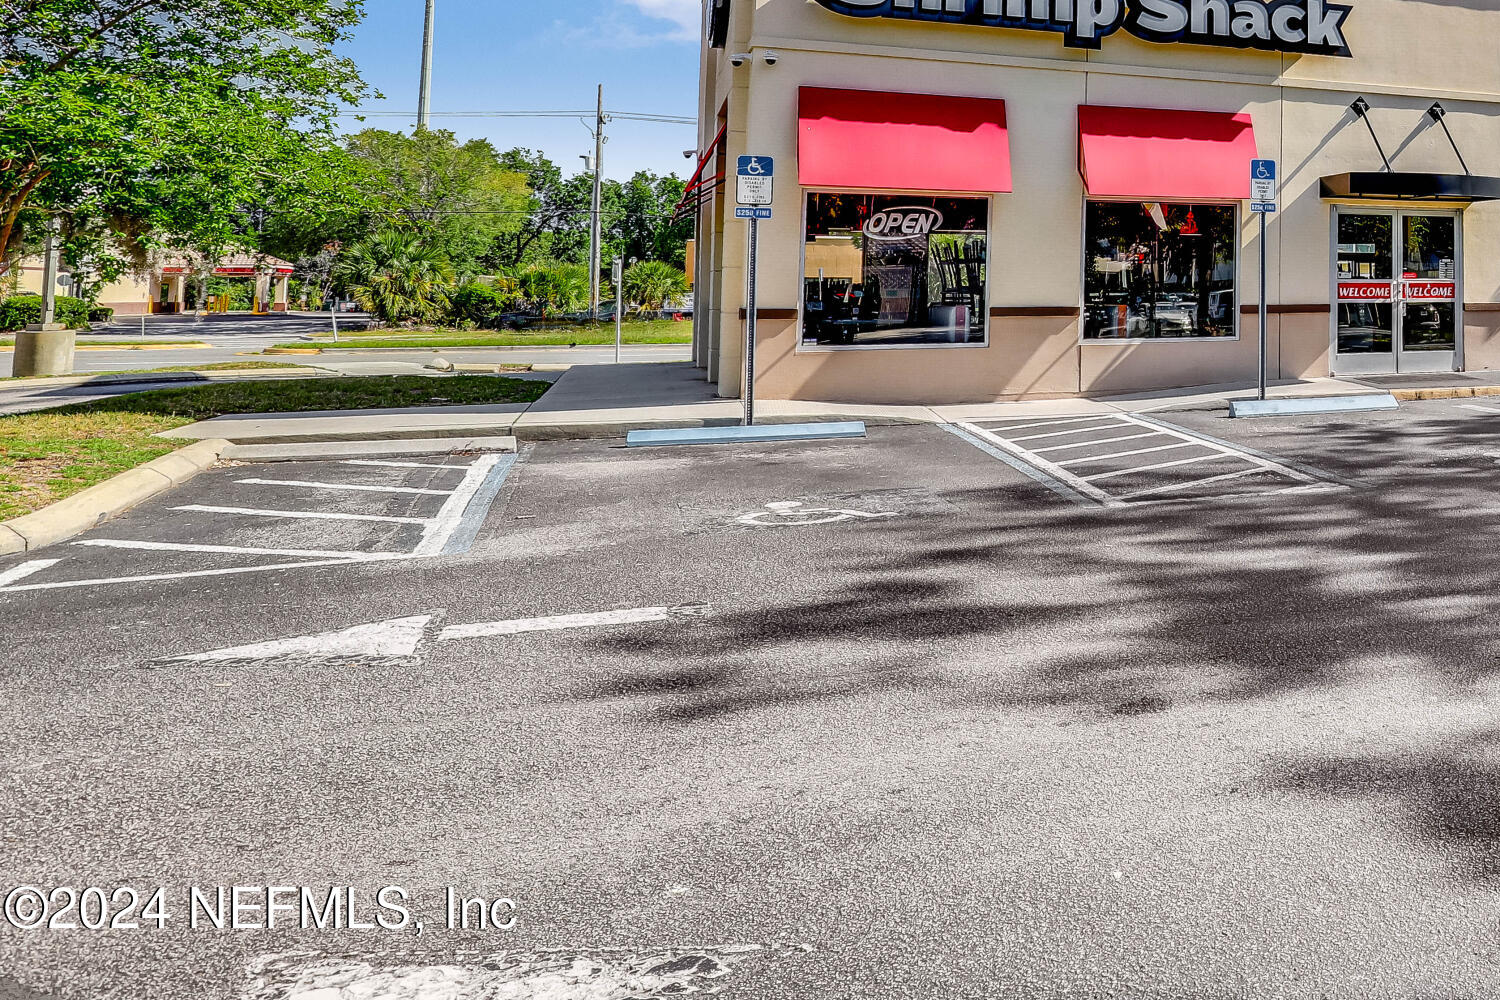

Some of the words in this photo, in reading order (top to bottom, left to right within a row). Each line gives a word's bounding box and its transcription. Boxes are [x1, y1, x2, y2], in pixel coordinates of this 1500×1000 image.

[755, 209, 770, 217] FINE
[868, 212, 935, 234] OPEN
[1339, 287, 1390, 297] WELCOME
